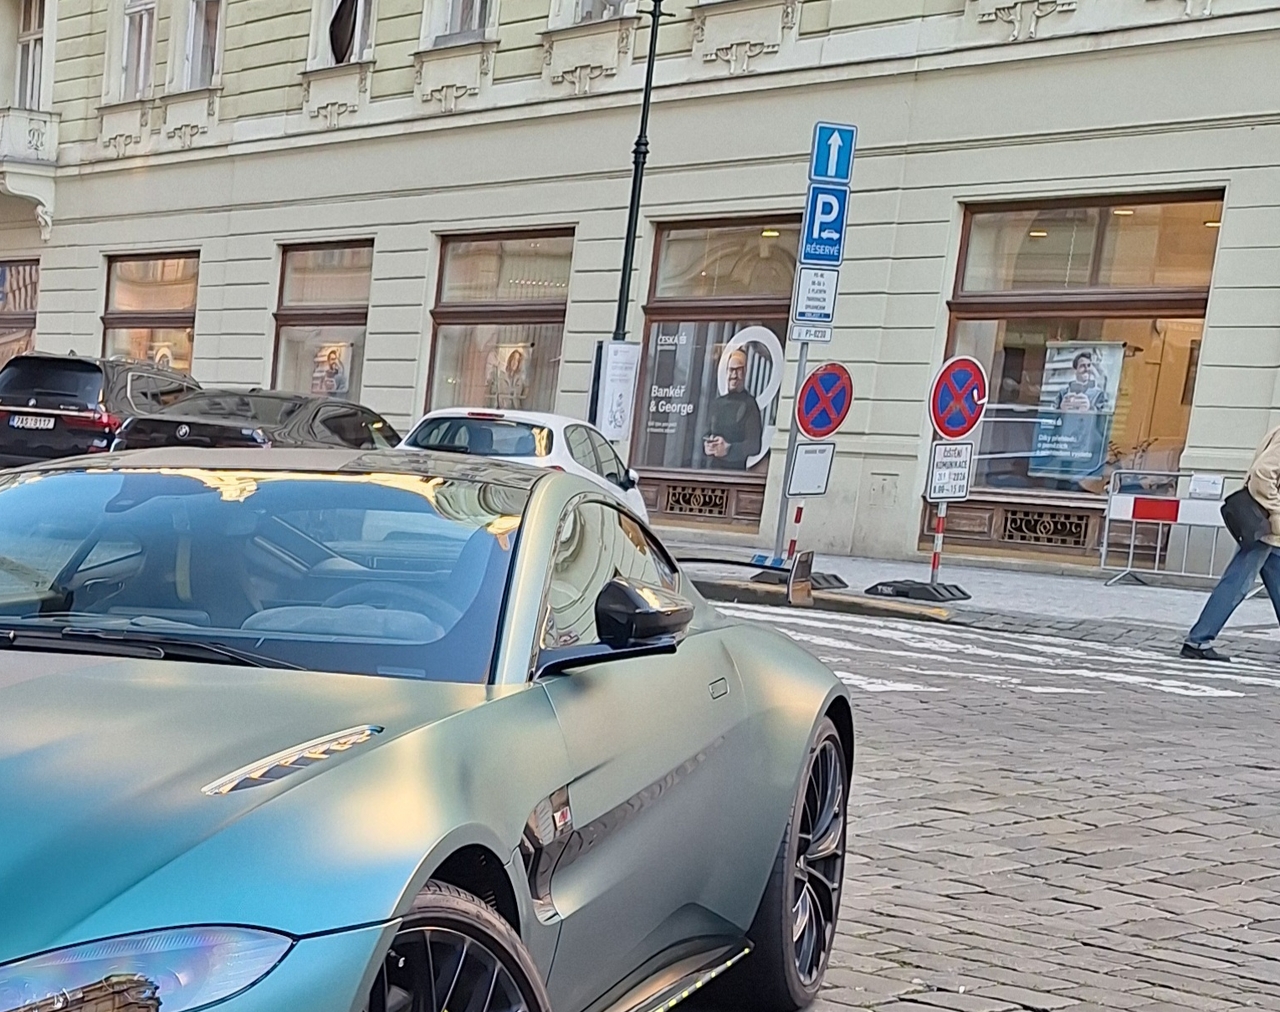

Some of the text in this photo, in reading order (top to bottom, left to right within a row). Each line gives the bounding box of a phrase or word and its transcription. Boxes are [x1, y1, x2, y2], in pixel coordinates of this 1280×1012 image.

[812, 193, 840, 239] P
[806, 242, 840, 256] RÉSERVÉ
[651, 384, 686, 398] Bankéř
[649, 400, 694, 416] & George
